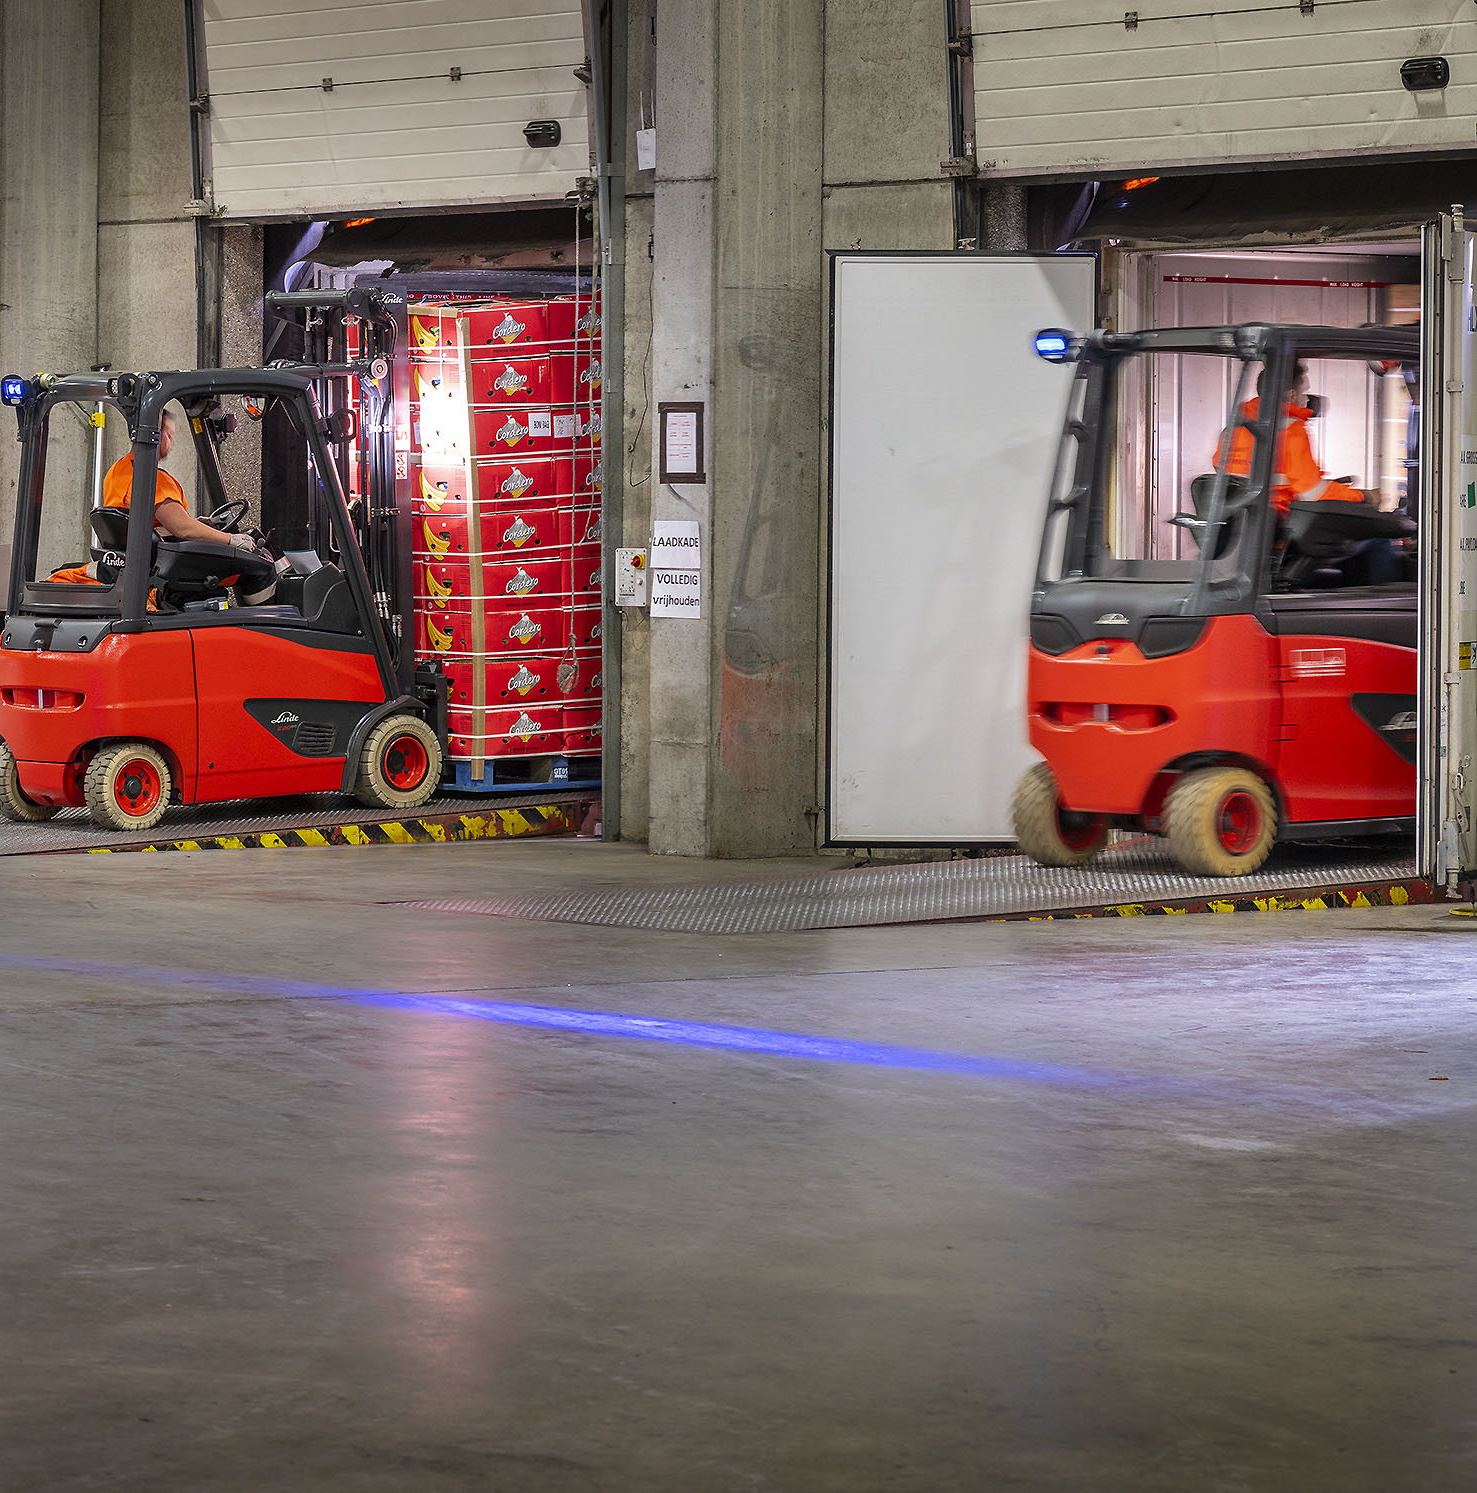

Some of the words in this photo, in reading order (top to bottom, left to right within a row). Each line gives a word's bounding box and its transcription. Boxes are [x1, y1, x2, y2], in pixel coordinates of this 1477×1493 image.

[493, 322, 526, 340] Cordero
[494, 374, 528, 391] Cordero
[496, 425, 529, 442] Cordero
[501, 477, 534, 493] Cordero
[503, 526, 536, 543] Cordero
[652, 537, 699, 548] LAADKADE
[103, 551, 126, 567] Linde
[505, 577, 539, 594] Cordero
[656, 573, 698, 586] VOLLEDIG
[652, 594, 700, 608] vrijhouden
[509, 623, 542, 639] Cordero
[508, 674, 541, 691] Cordero
[270, 711, 300, 724] Linde
[509, 721, 542, 738] Cordero
